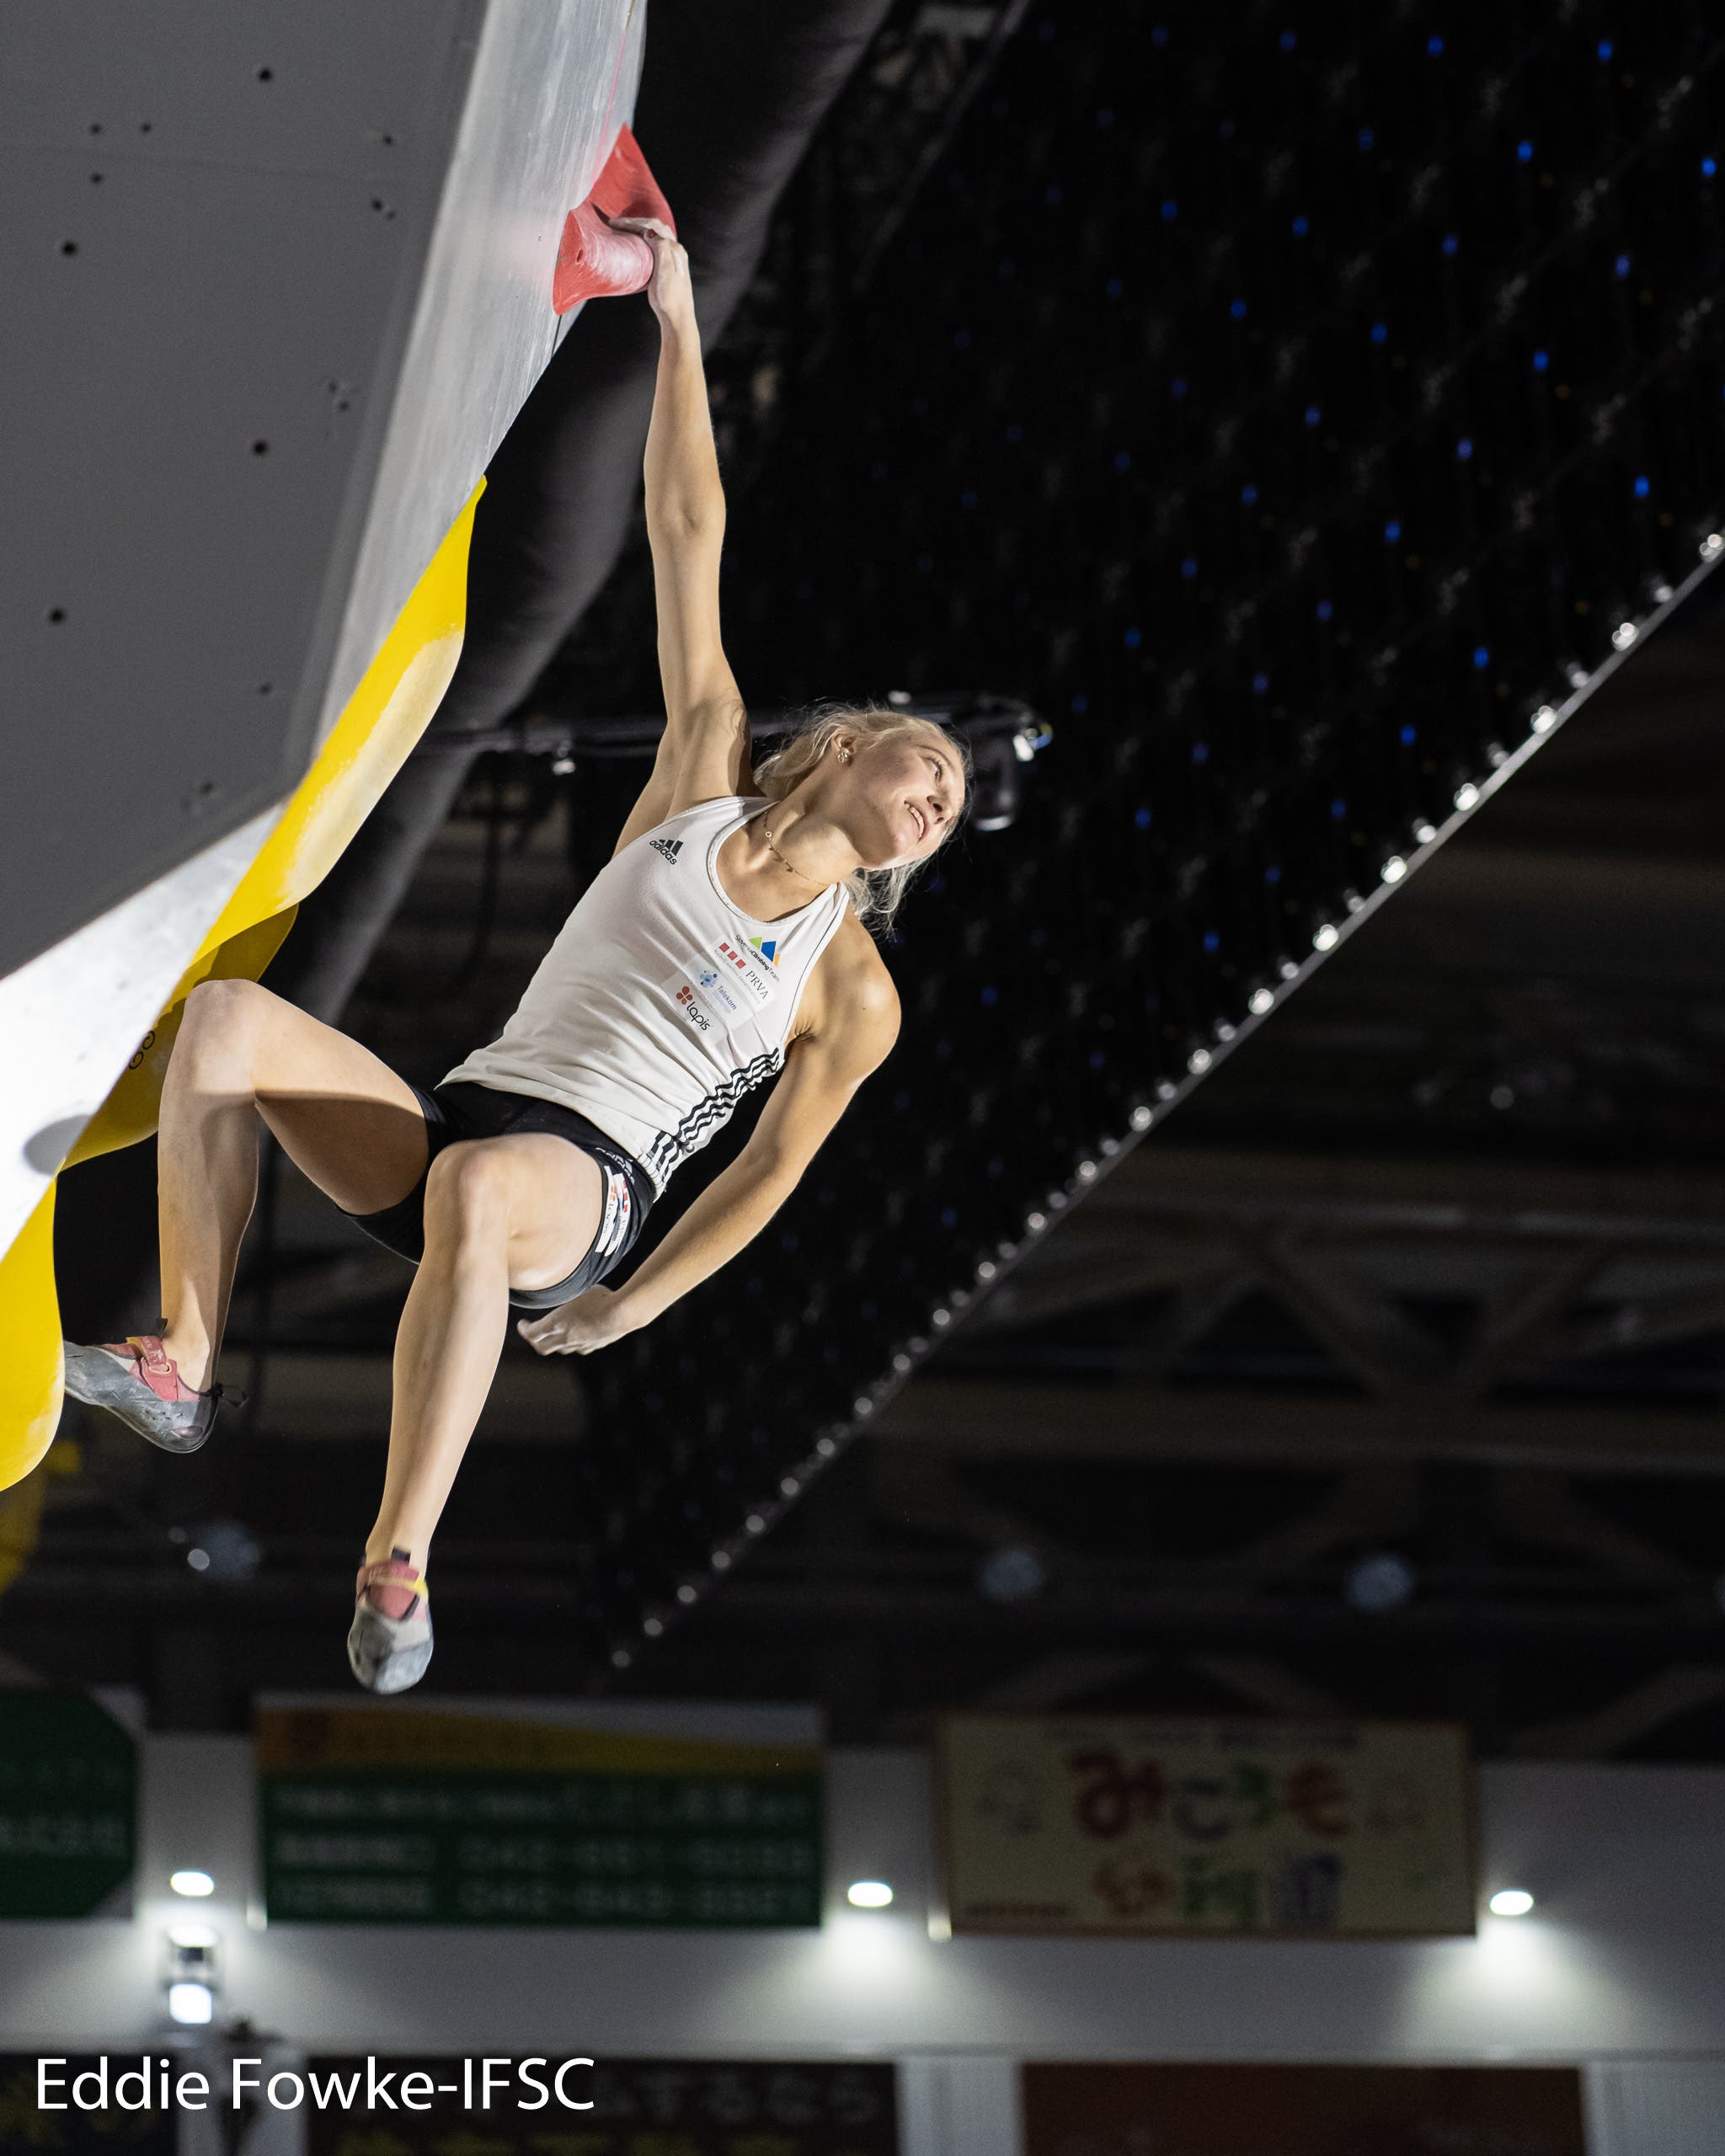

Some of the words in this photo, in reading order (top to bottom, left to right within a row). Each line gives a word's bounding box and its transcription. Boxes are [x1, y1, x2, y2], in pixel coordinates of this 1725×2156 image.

[649, 840, 677, 865] adidas
[717, 985, 737, 1010] Telekom
[745, 970, 768, 1000] PRVA
[686, 1001, 710, 1031] lapis
